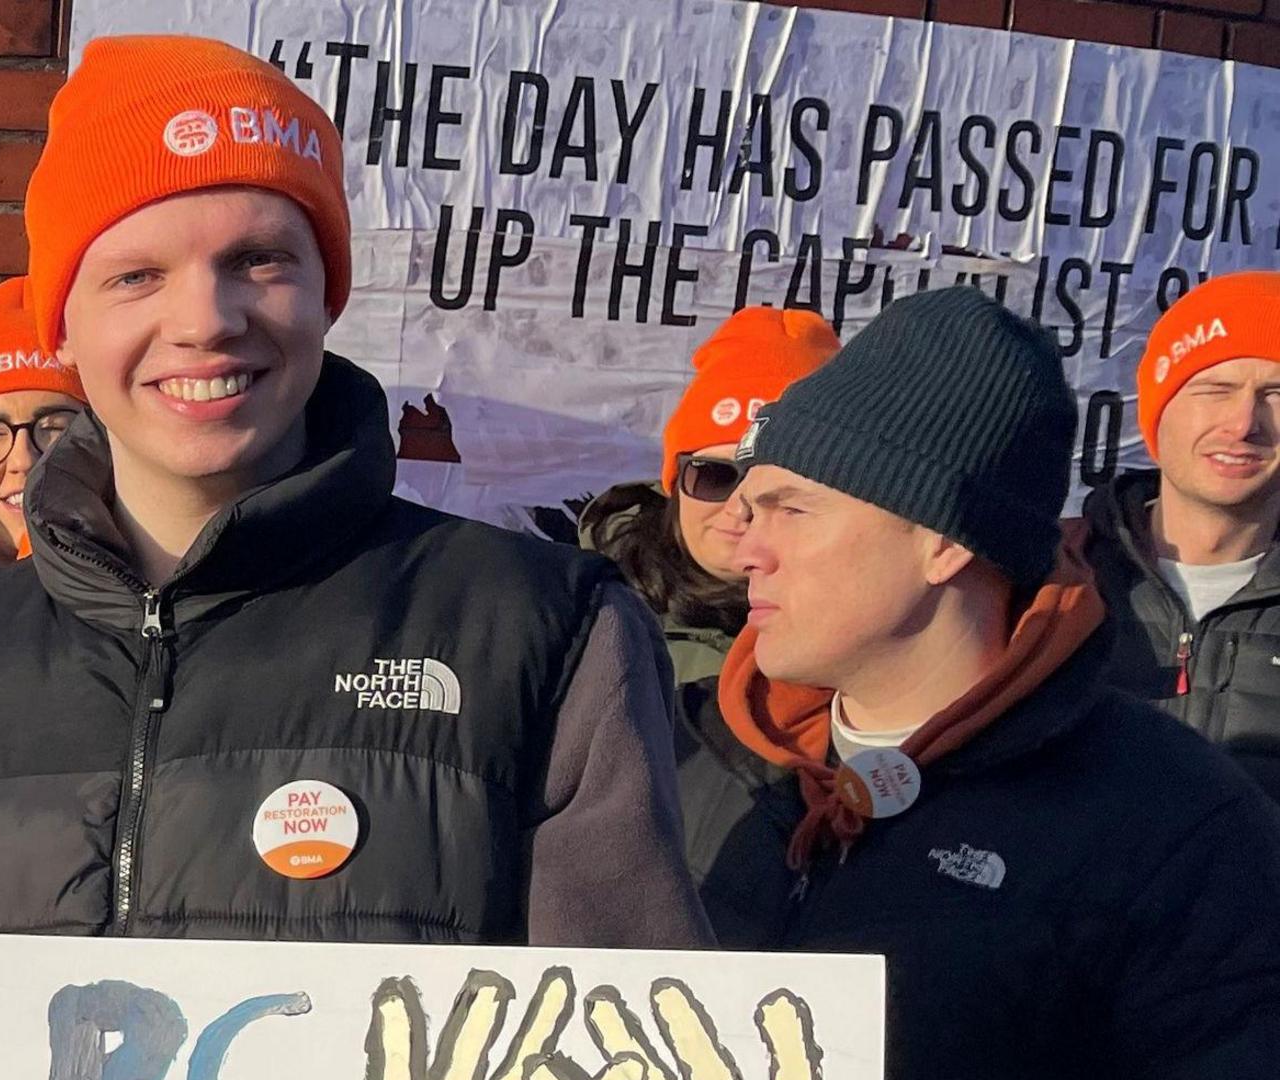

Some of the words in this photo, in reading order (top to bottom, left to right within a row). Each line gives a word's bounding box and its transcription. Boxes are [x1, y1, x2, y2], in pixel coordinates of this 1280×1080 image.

[228, 105, 326, 168] BMA
[500, 70, 660, 184] DAY
[680, 86, 829, 202] HAS
[856, 104, 1125, 229] PASSED
[1144, 136, 1260, 245] FOR
[429, 204, 535, 311] UP
[569, 214, 708, 326] THE
[733, 228, 1134, 359] CAPIST
[1170, 316, 1228, 368] BMA
[374, 658, 422, 676] THE
[334, 673, 420, 693] NORTH
[357, 690, 420, 709] FACE
[288, 791, 322, 808] PAY
[264, 805, 348, 821] RESTORATION
[284, 818, 328, 835] NOW
